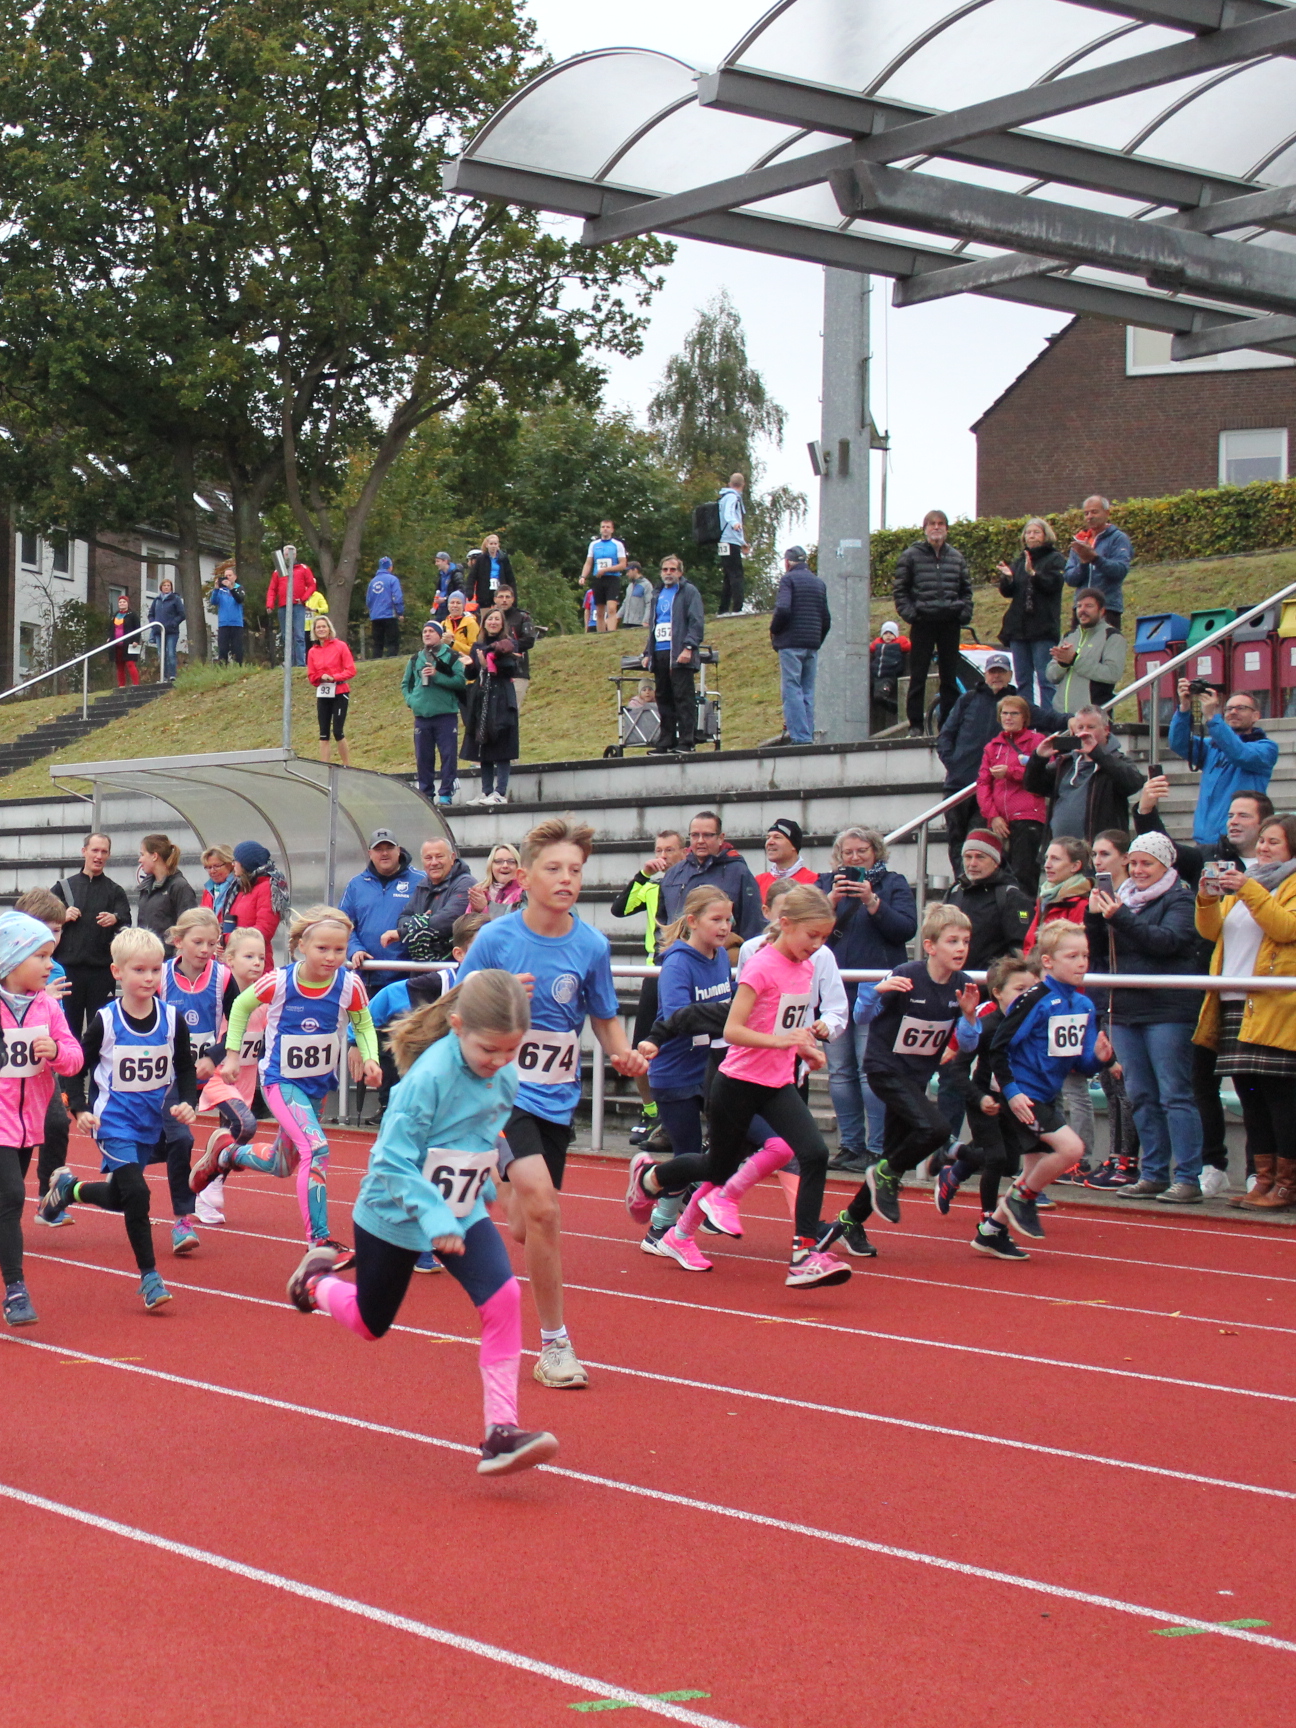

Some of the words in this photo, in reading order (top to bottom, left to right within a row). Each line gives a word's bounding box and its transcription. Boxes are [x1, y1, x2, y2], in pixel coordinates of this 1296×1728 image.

[320, 686, 331, 695] 93
[241, 1039, 262, 1059] 79
[902, 1027, 947, 1048] 670
[287, 1044, 333, 1070] 681
[518, 1042, 575, 1073] 674
[119, 1055, 169, 1083] 659
